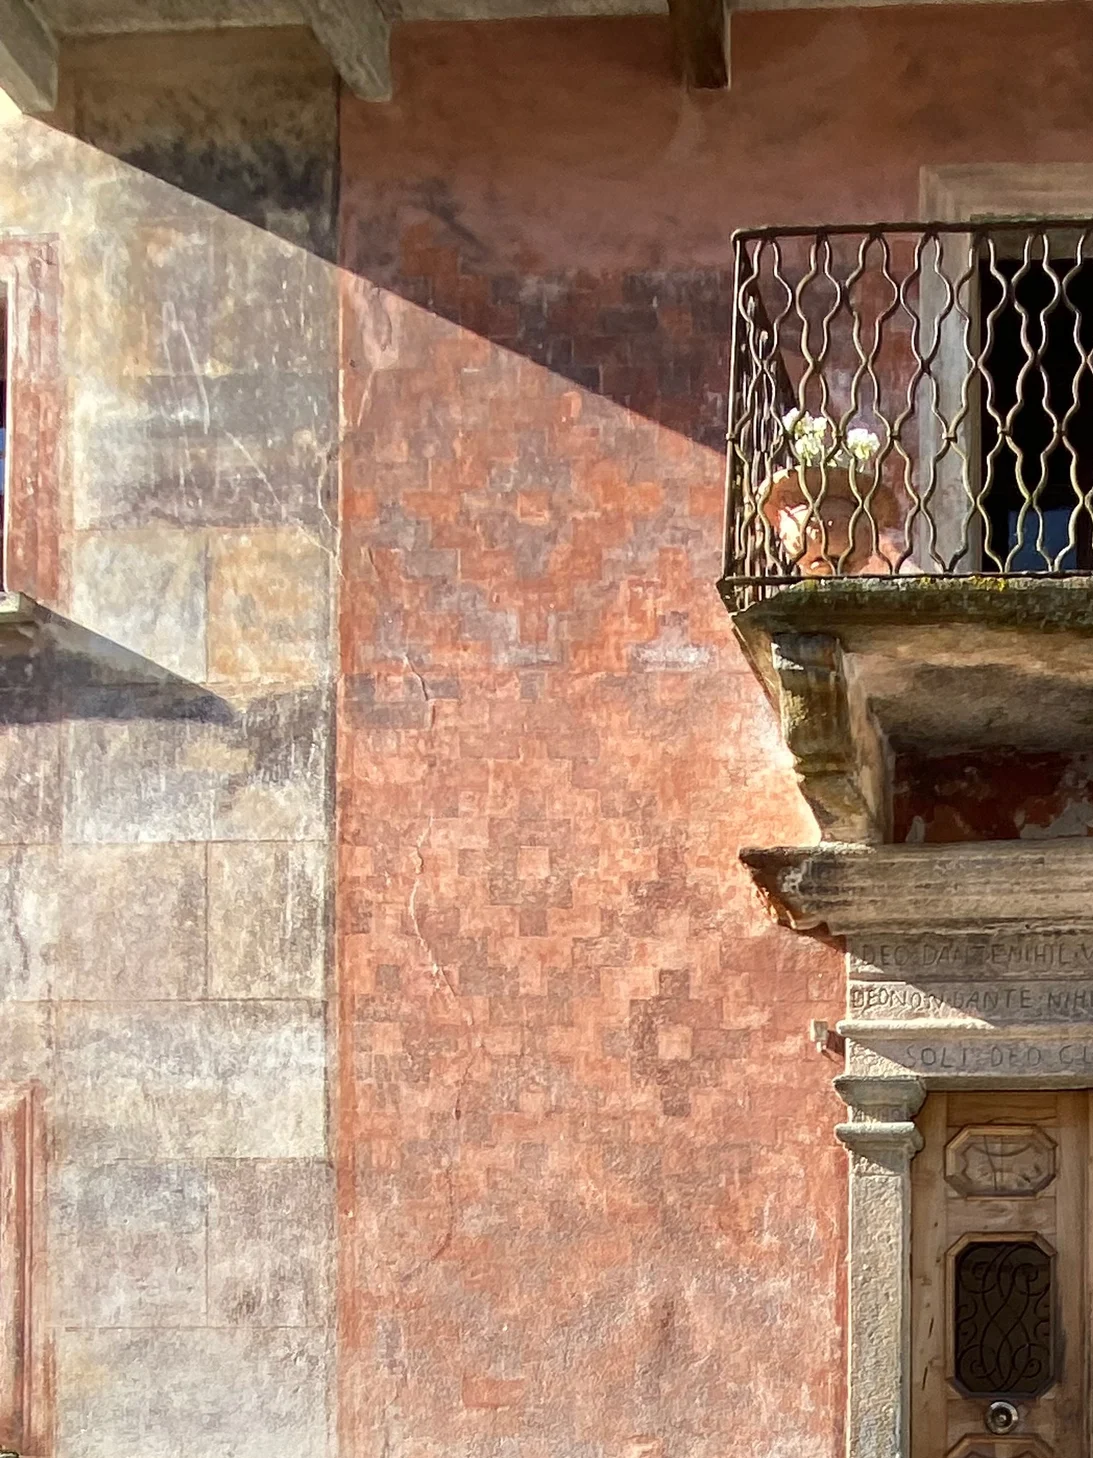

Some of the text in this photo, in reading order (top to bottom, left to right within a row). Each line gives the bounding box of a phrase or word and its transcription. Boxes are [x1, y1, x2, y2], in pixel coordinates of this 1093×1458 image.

[862, 944, 909, 966] DEO
[1008, 943, 1072, 966] NIHIL
[904, 1044, 967, 1068] SOLI
[990, 1045, 1042, 1067] DEO
